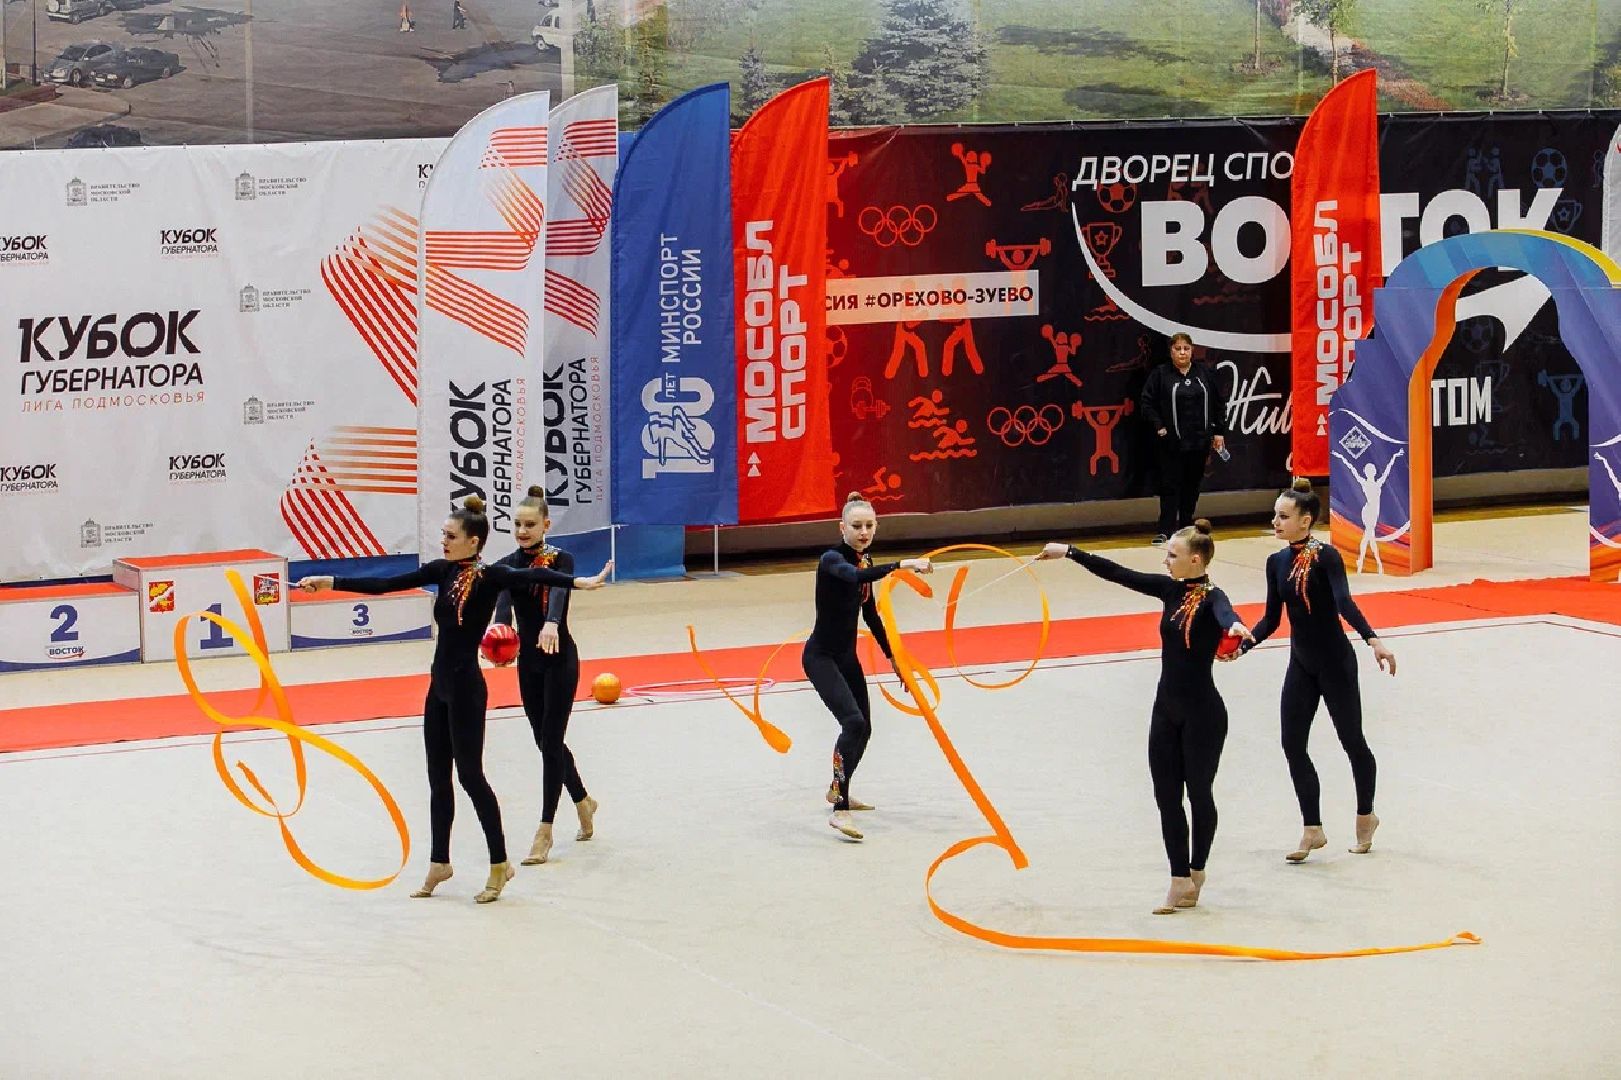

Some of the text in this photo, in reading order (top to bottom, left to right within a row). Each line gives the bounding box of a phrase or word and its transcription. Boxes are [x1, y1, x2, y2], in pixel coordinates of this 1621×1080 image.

[1071, 151, 1294, 192] ДВОРЕЦ СПО
[0, 234, 47, 251] УБОК
[0, 251, 49, 262] БЕРНАТОРА
[160, 228, 217, 245] КУБОК
[160, 244, 218, 255] ГУБЕРНАТОРА
[660, 233, 681, 363] МИНСПОРТ
[681, 249, 702, 345] РОССИИ
[826, 286, 1034, 311] СИЯ #ОРЕХОВО-ЗУЕВО
[1313, 199, 1339, 406] МОСОБЛ
[1342, 242, 1362, 384] ПОРТ
[18, 309, 202, 363] КУБОК
[744, 219, 777, 444] МОСОБЛ
[779, 263, 808, 440] СПОРТ
[21, 362, 204, 395] ГУБЕРНАТОРА
[664, 372, 678, 399] ЛЕТ
[22, 391, 205, 413] ЛИГА ПОДМОСКОВЬЯ
[1430, 375, 1492, 427] ТОМ
[449, 379, 488, 513] УБОК
[568, 357, 593, 504] ГУБЕРНАТОРА
[0, 463, 57, 482] КУБОК
[168, 452, 226, 470] КУБОК
[492, 378, 512, 534] ГУБЕРНАТОРА
[50, 604, 79, 643] 2
[200, 603, 234, 650] 1
[352, 603, 370, 627] 3
